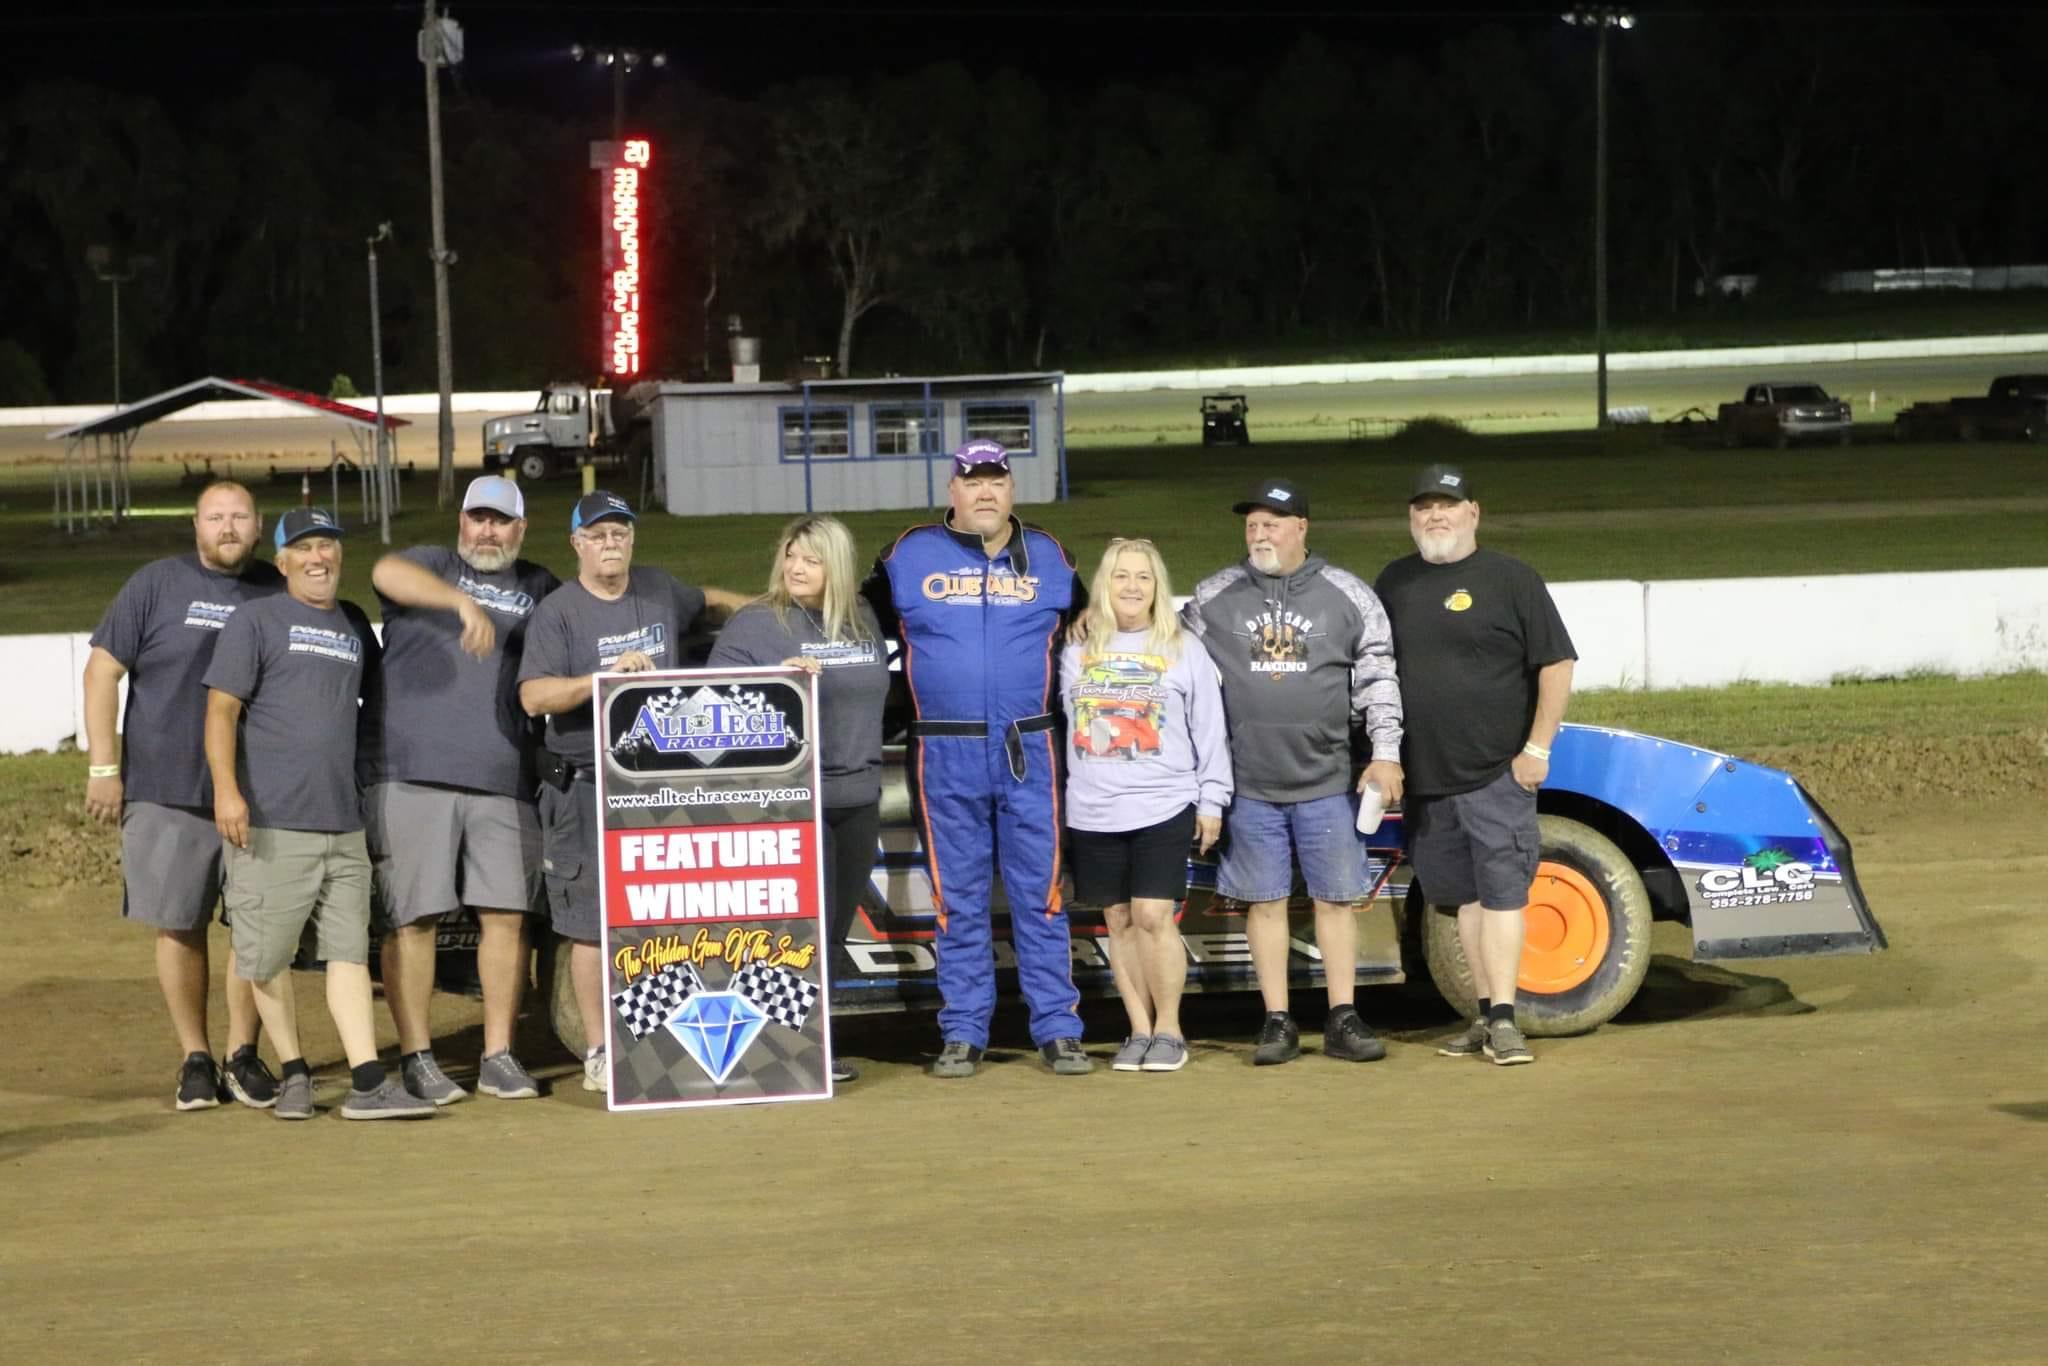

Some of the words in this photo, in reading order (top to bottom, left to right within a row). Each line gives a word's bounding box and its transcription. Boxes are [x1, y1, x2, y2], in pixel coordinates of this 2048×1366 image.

[666, 734, 781, 750] RACEWAY
[608, 787, 811, 808] www.alltechraceway.com
[620, 828, 801, 872] FEATURE
[624, 877, 800, 922] WINNER
[614, 945, 642, 985] The
[641, 935, 691, 975] Hidden
[691, 927, 724, 969] Gem
[724, 927, 749, 972] Of
[748, 929, 774, 963] The
[767, 935, 816, 969] South
